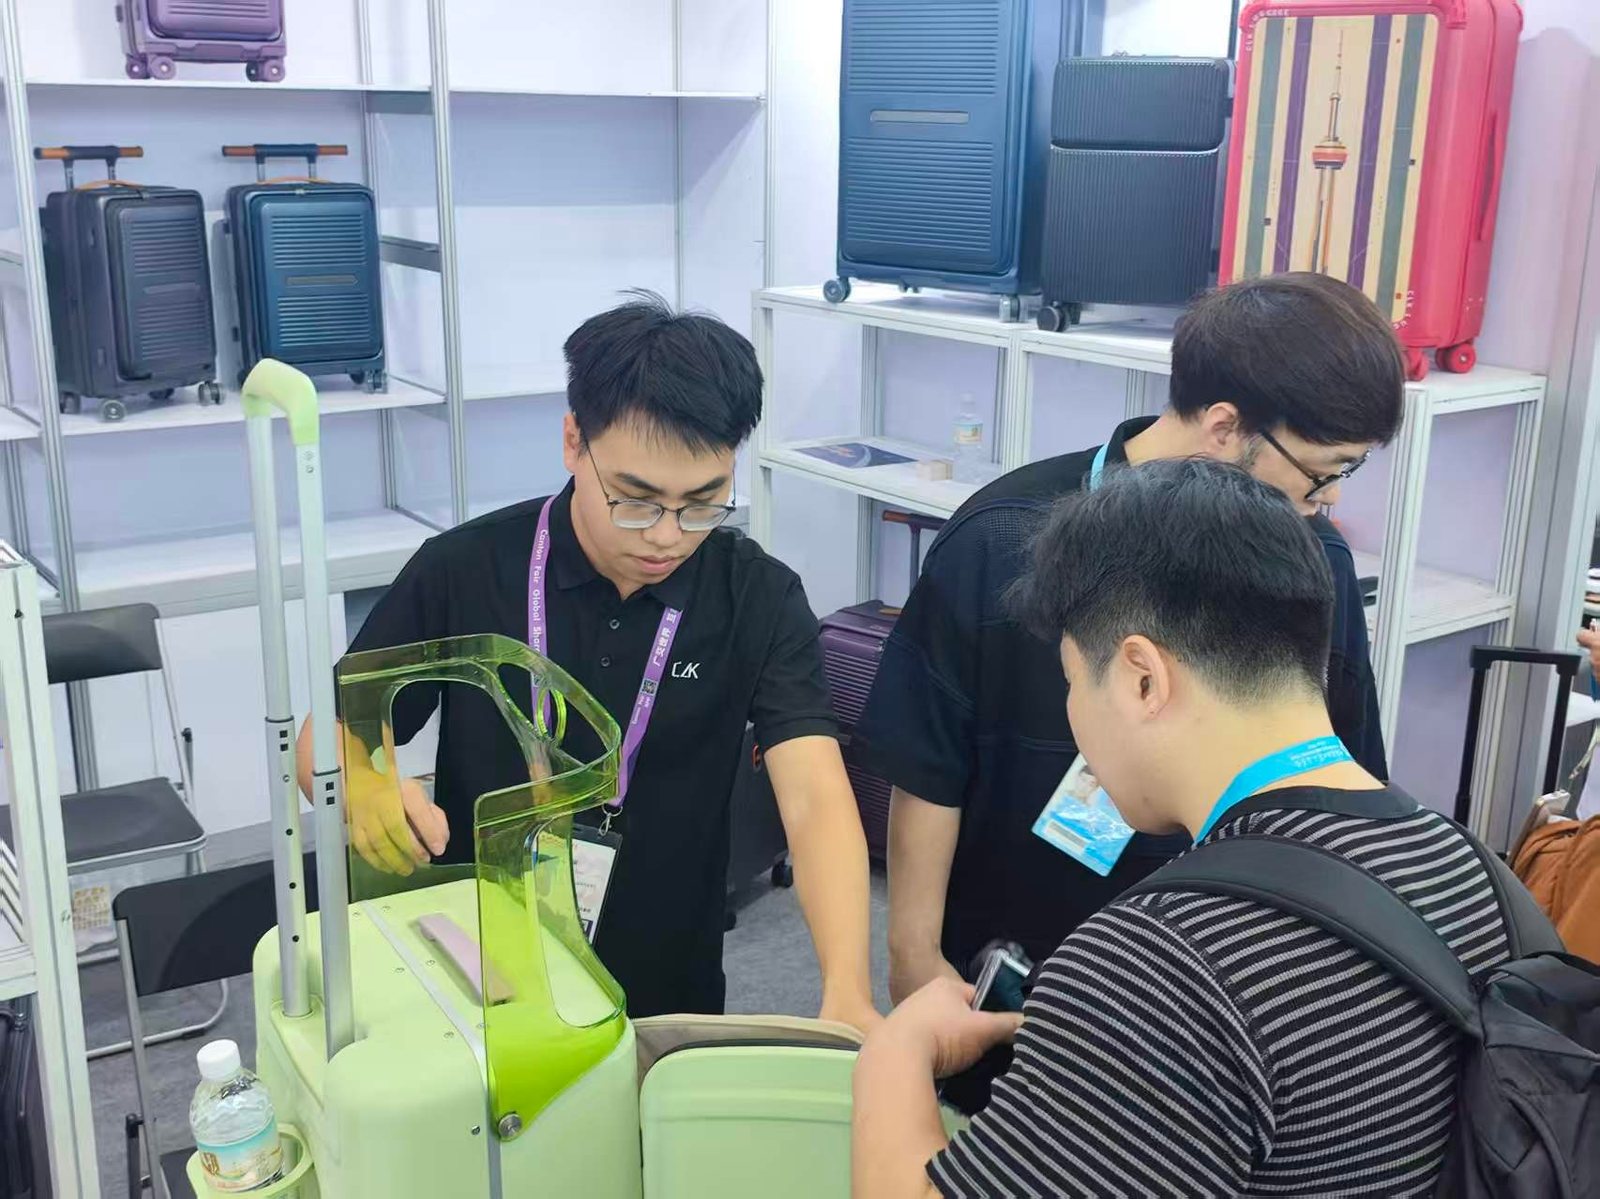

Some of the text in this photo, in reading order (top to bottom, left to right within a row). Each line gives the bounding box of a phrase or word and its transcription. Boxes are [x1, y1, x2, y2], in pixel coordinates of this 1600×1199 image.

[535, 529, 548, 561] Canton
[533, 565, 542, 584] Fair
[532, 589, 541, 622] Global
